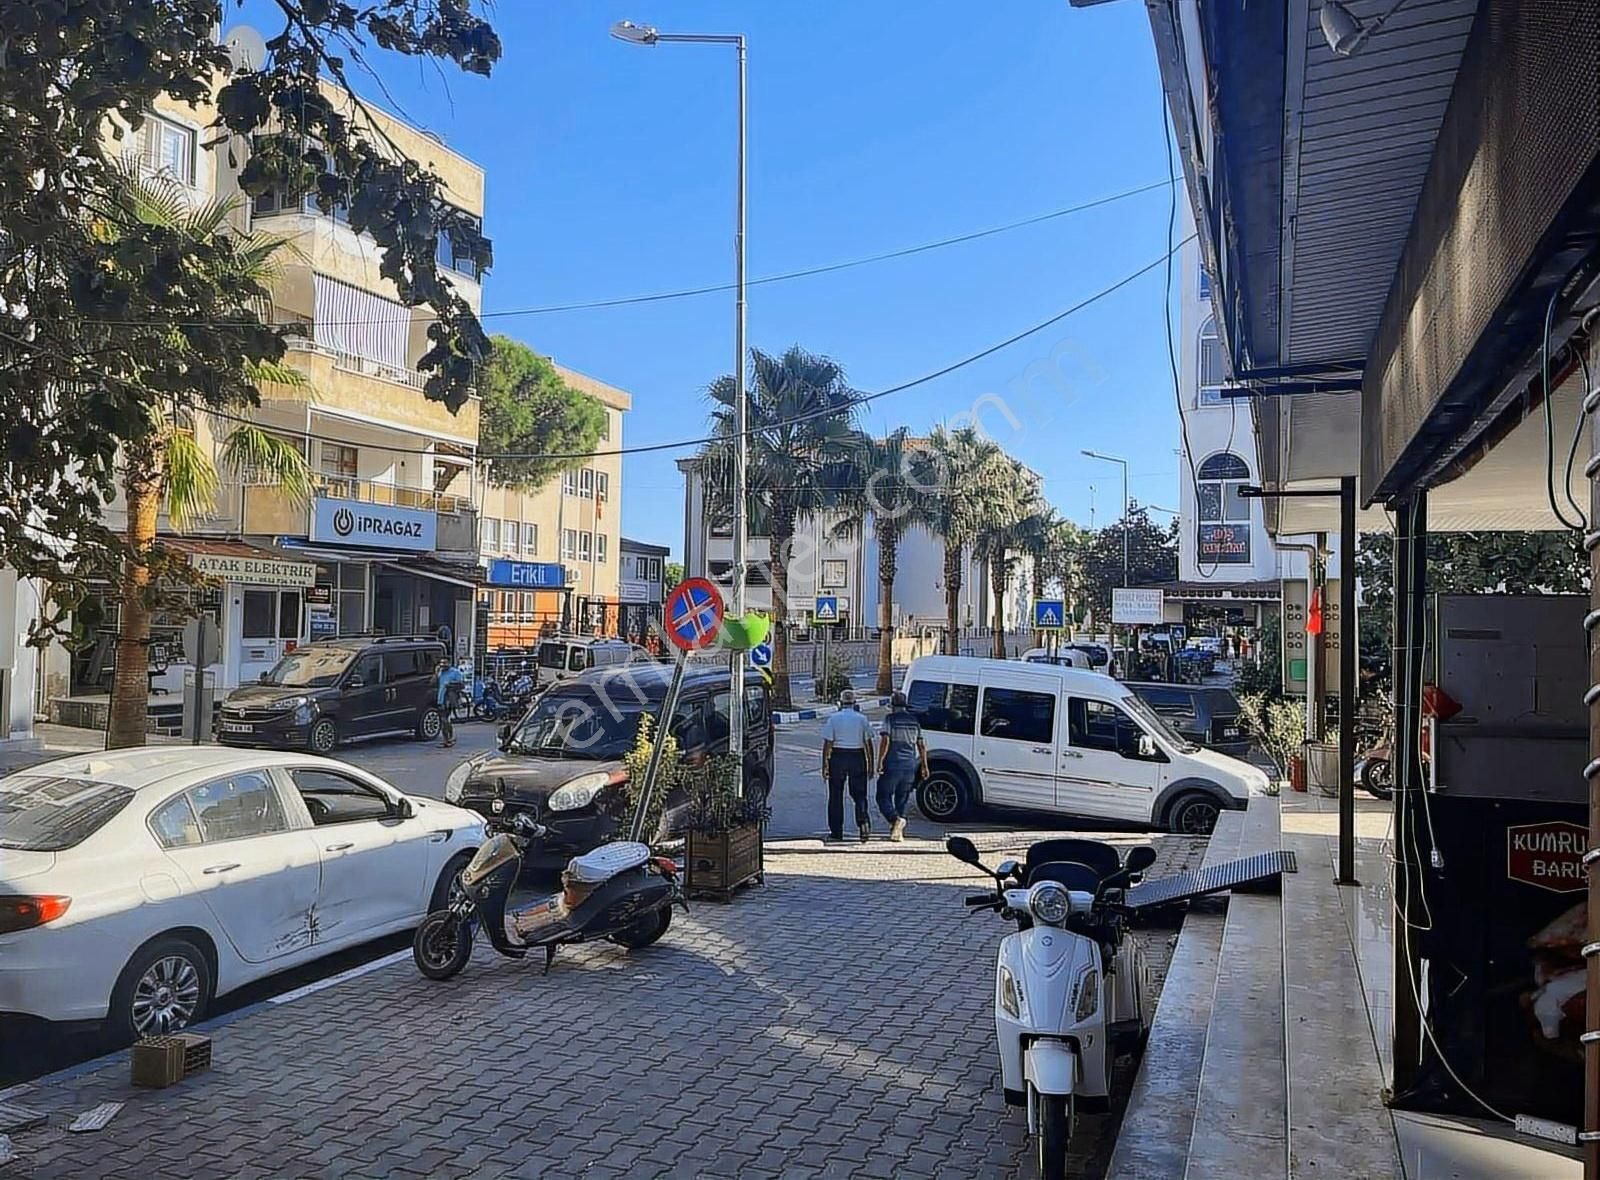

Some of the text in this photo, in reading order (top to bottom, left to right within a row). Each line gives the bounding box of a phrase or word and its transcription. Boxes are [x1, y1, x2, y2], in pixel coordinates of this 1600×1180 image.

[198, 558, 239, 571] ATAK
[244, 562, 313, 578] ELEKTRİK
[511, 564, 545, 586] Erikli
